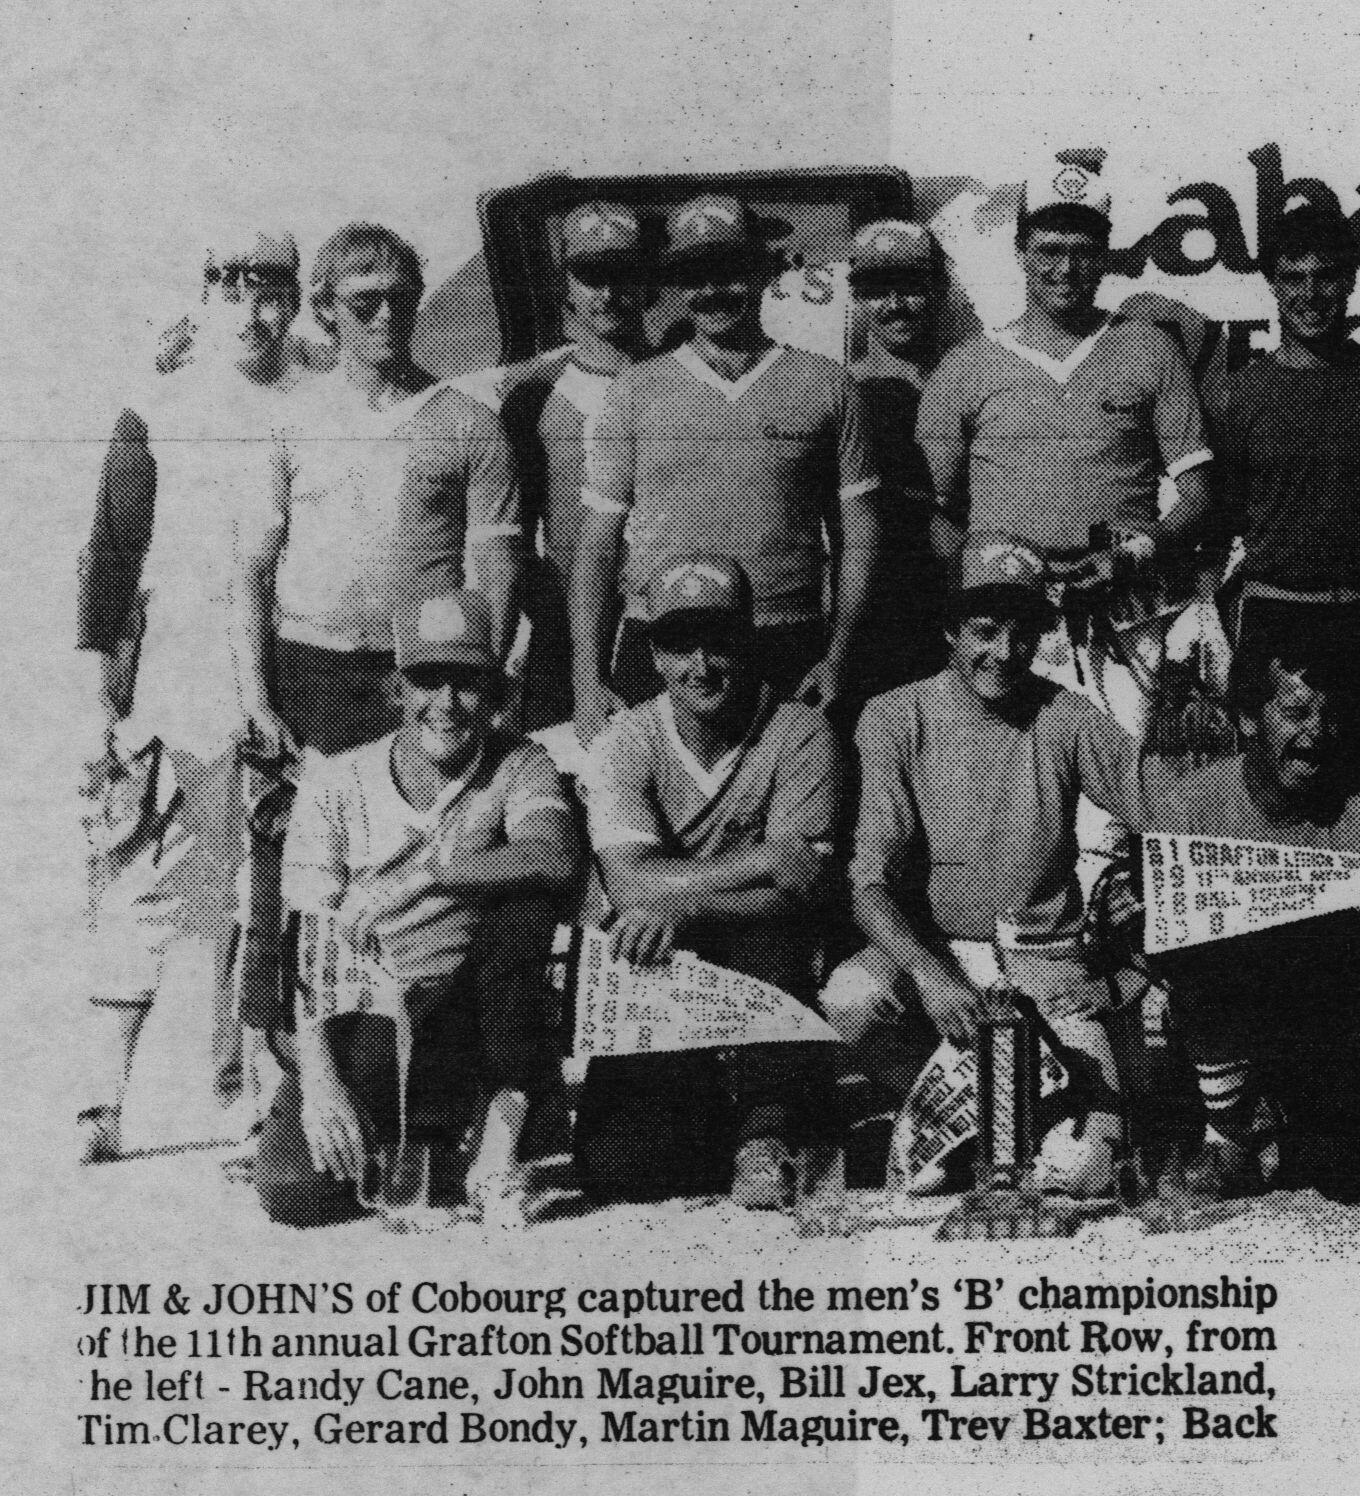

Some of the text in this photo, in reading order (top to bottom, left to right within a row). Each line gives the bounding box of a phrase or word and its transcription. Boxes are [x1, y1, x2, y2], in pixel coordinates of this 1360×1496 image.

[1189, 841, 1280, 867] GRAFTON
[81, 1283, 151, 1315] JIM
[163, 1283, 191, 1316] &
[366, 1281, 402, 1314] of
[411, 1280, 567, 1320] Cobourg
[577, 1278, 745, 1319] captured
[757, 1277, 815, 1313] the
[1018, 1274, 1278, 1316] championship
[77, 1319, 1278, 1359] of the 11th annual Grafton Softball Tournament. Front Row, from
[145, 1369, 203, 1402] left
[218, 1385, 231, 1393] -
[243, 1368, 365, 1407] Randy
[376, 1368, 479, 1406] Cane,
[493, 1366, 585, 1400] John
[596, 1366, 765, 1406] Maguire,
[779, 1364, 846, 1399] Bill
[857, 1365, 937, 1404] Jex,
[950, 1364, 1060, 1404] Larry
[1071, 1360, 1276, 1401] Strickland,
[163, 1412, 300, 1450] Clarey,
[314, 1410, 449, 1445] Gerard
[459, 1409, 588, 1450] Bondy,
[600, 1409, 731, 1443] Martin
[740, 1408, 909, 1448] Maguire,
[921, 1408, 1012, 1442] Trev
[1022, 1407, 1165, 1446] Baxter;
[1182, 1404, 1278, 1440] Back
